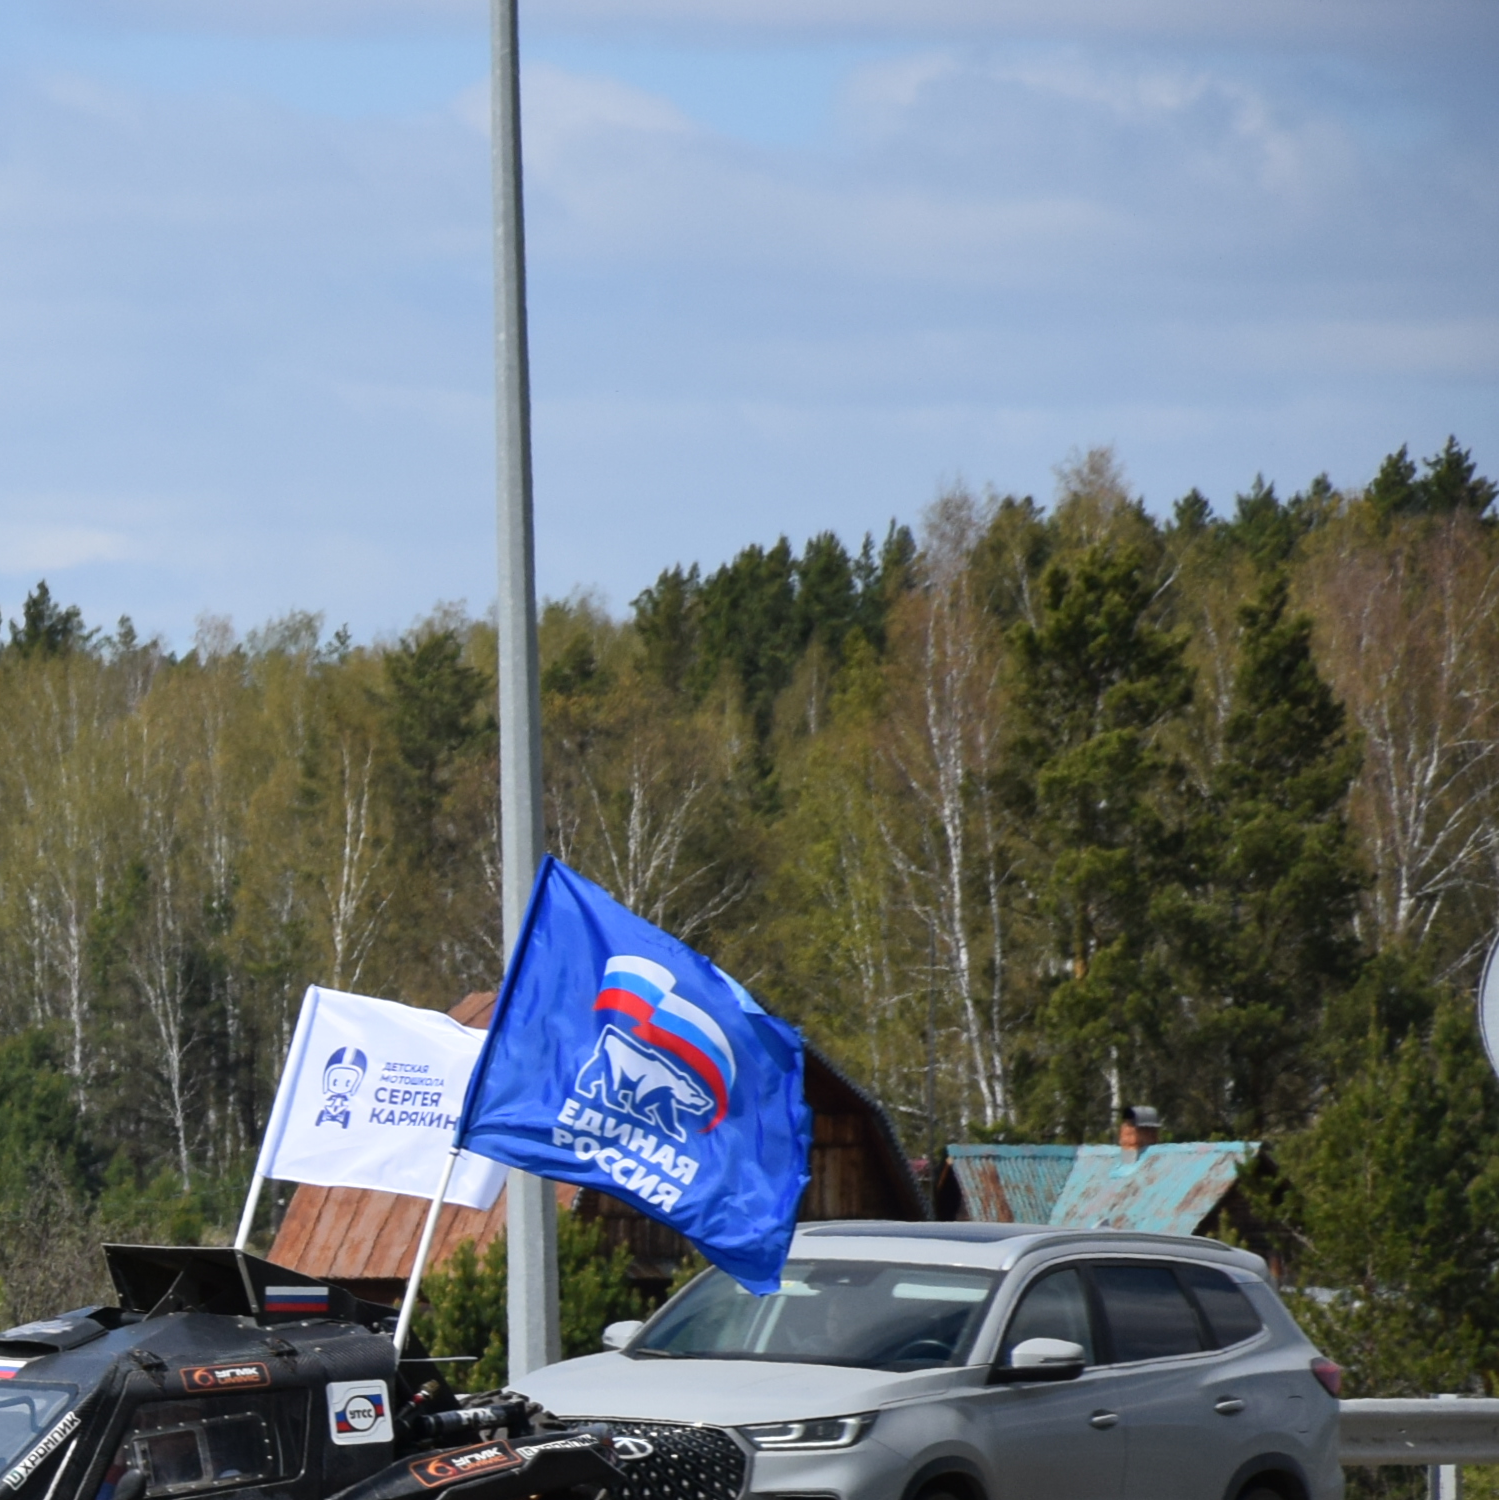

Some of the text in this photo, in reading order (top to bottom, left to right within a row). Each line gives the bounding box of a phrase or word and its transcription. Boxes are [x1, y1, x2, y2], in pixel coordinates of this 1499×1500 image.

[382, 1061, 429, 1074] ДЕТСКАЯ
[380, 1074, 445, 1087] МОТОШКОЛА
[374, 1086, 442, 1108] СЕРГЕЯ
[368, 1107, 461, 1131] КАРЯКИН
[556, 1097, 700, 1186] ЕДИНАЯ
[552, 1126, 683, 1213] РОССИЯ
[20, 1411, 80, 1475] ХРОМПИК
[451, 1446, 504, 1470] УГМК
